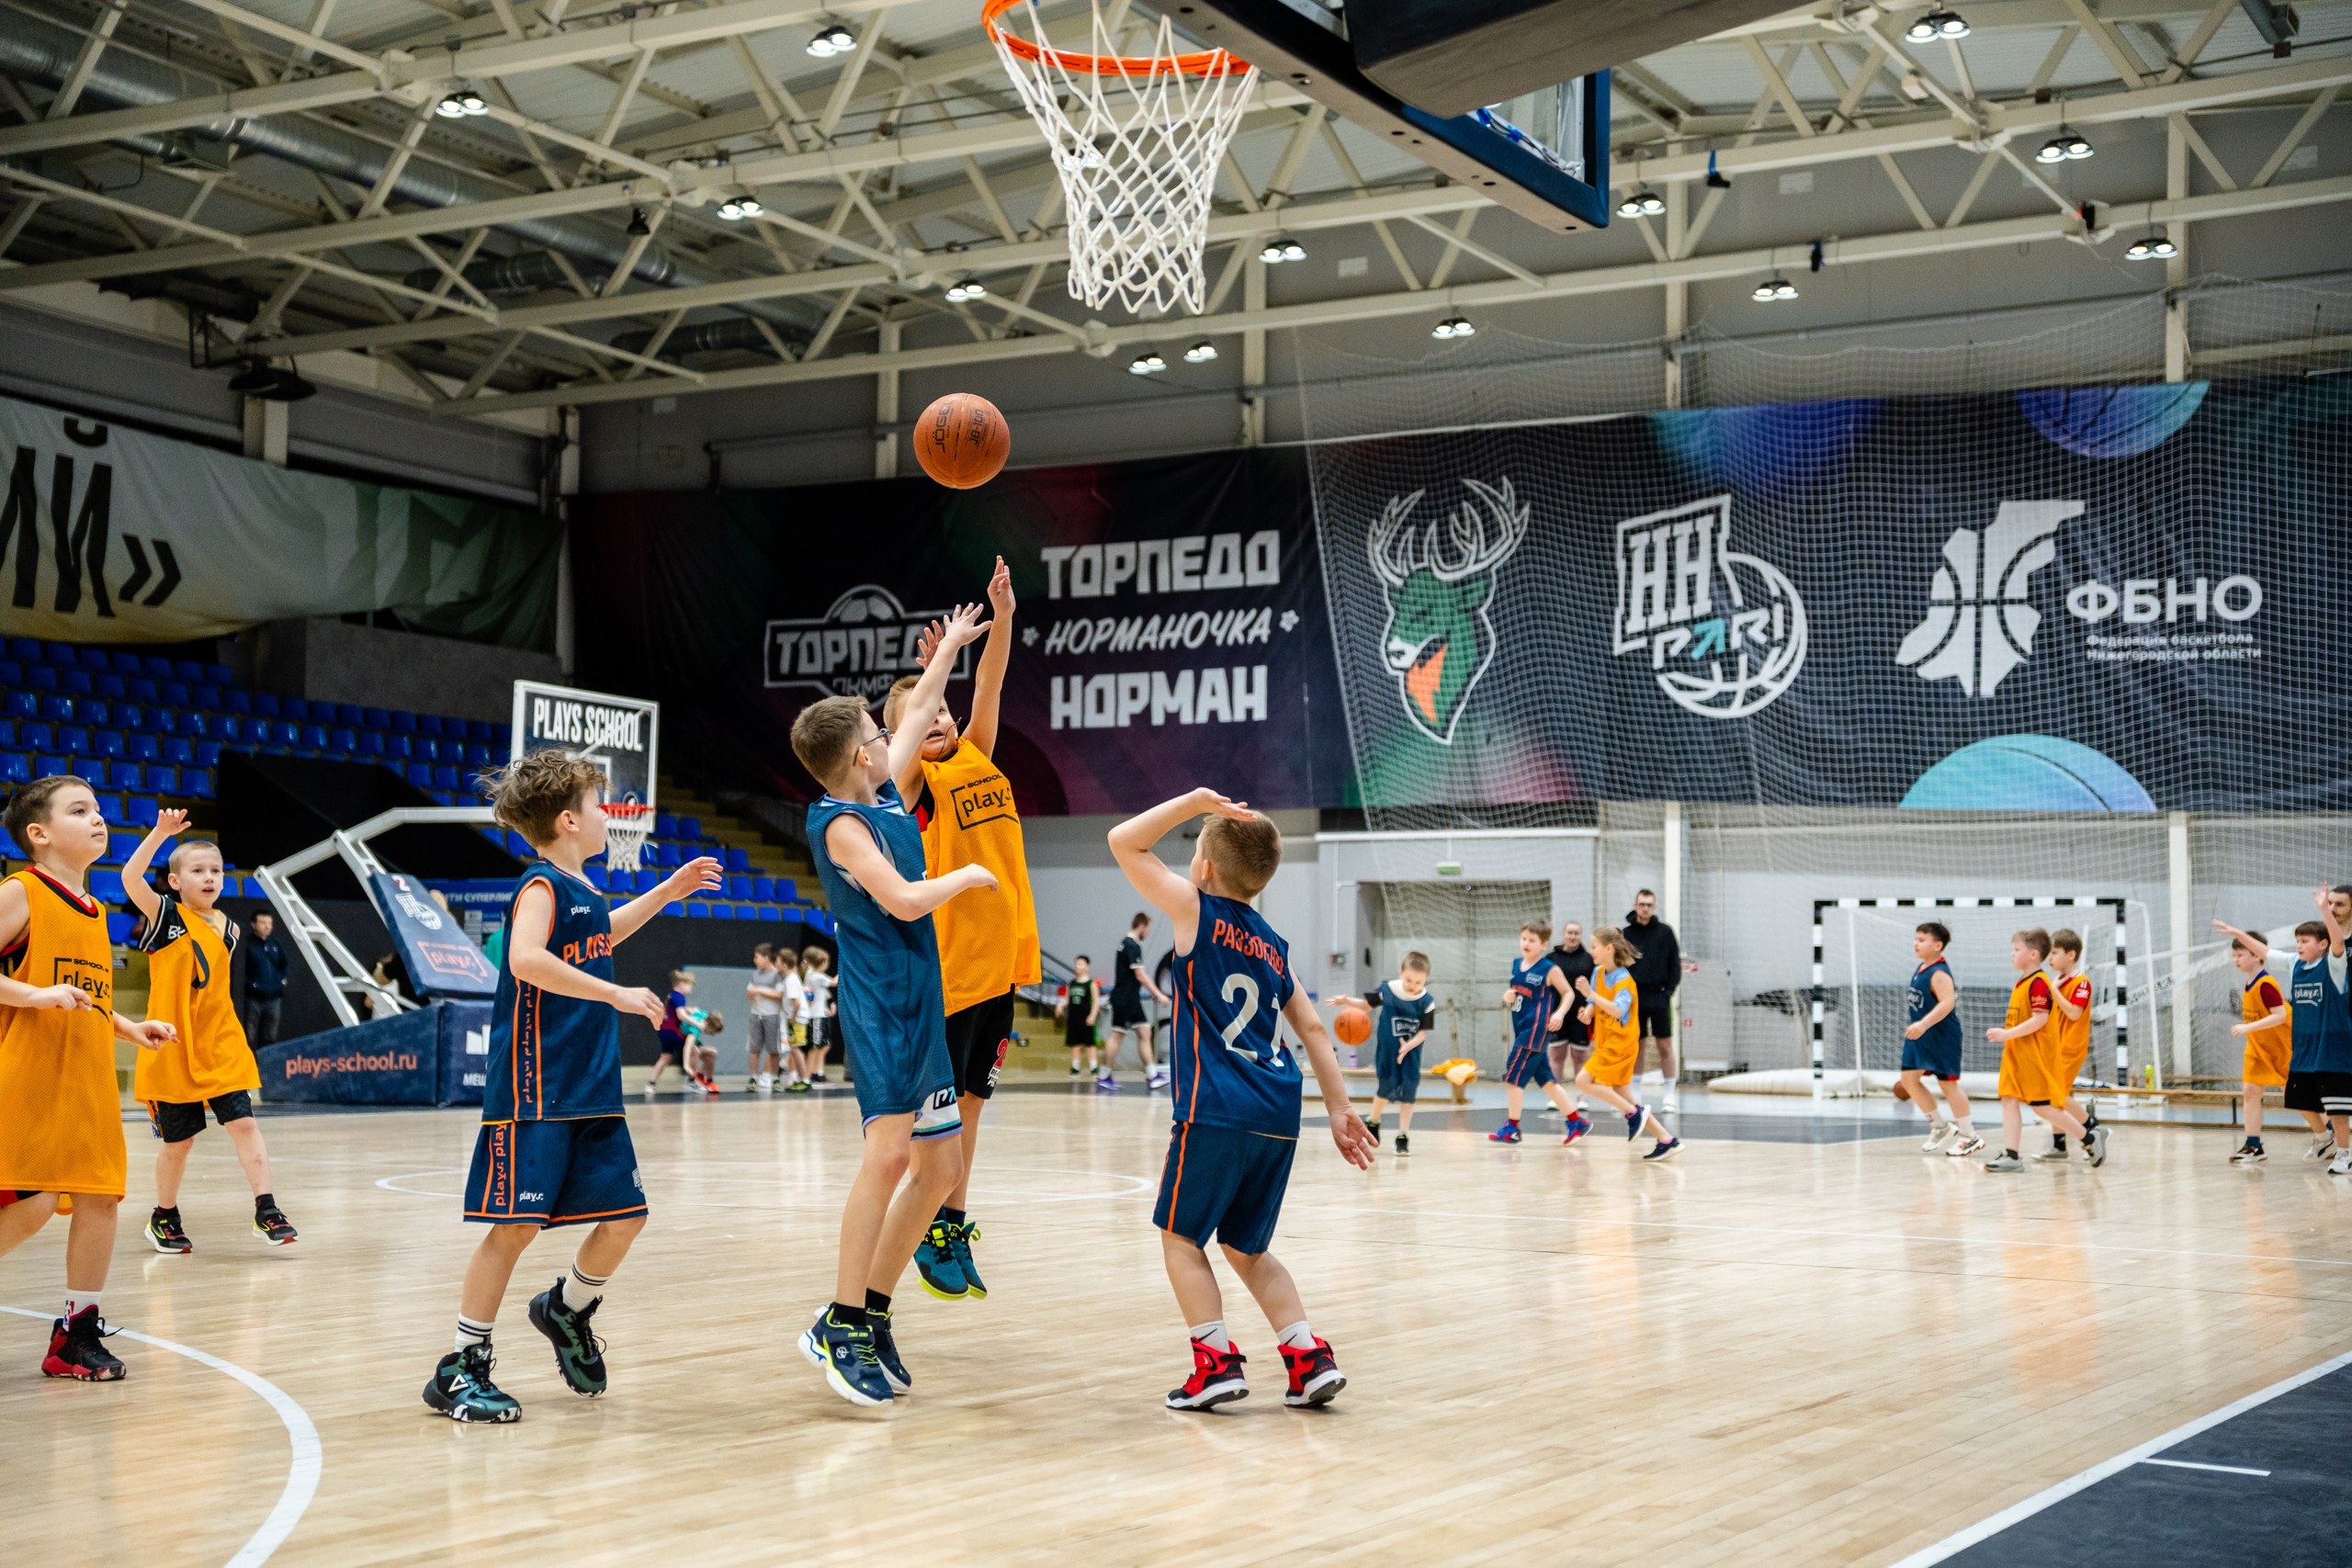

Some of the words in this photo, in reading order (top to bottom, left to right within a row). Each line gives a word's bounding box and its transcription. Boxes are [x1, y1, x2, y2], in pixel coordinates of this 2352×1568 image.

[1040, 529, 1281, 600] ТОРПЕДО
[2067, 574, 2263, 624] ФБНО
[776, 623, 960, 675] ТОРПЕД
[1044, 606, 1273, 656] НОРМАНОЧКА
[2086, 634, 2167, 649] Федерация
[2171, 631, 2254, 647] баскетбола
[2086, 647, 2199, 662] Нижегородской
[2202, 646, 2262, 660] области
[1050, 665, 1268, 729] НОРМАН
[533, 697, 582, 743] PLAYS
[583, 705, 643, 752] SCHOOL
[967, 773, 1002, 788] SCHOOL
[286, 1051, 417, 1079] plays-school.ru
